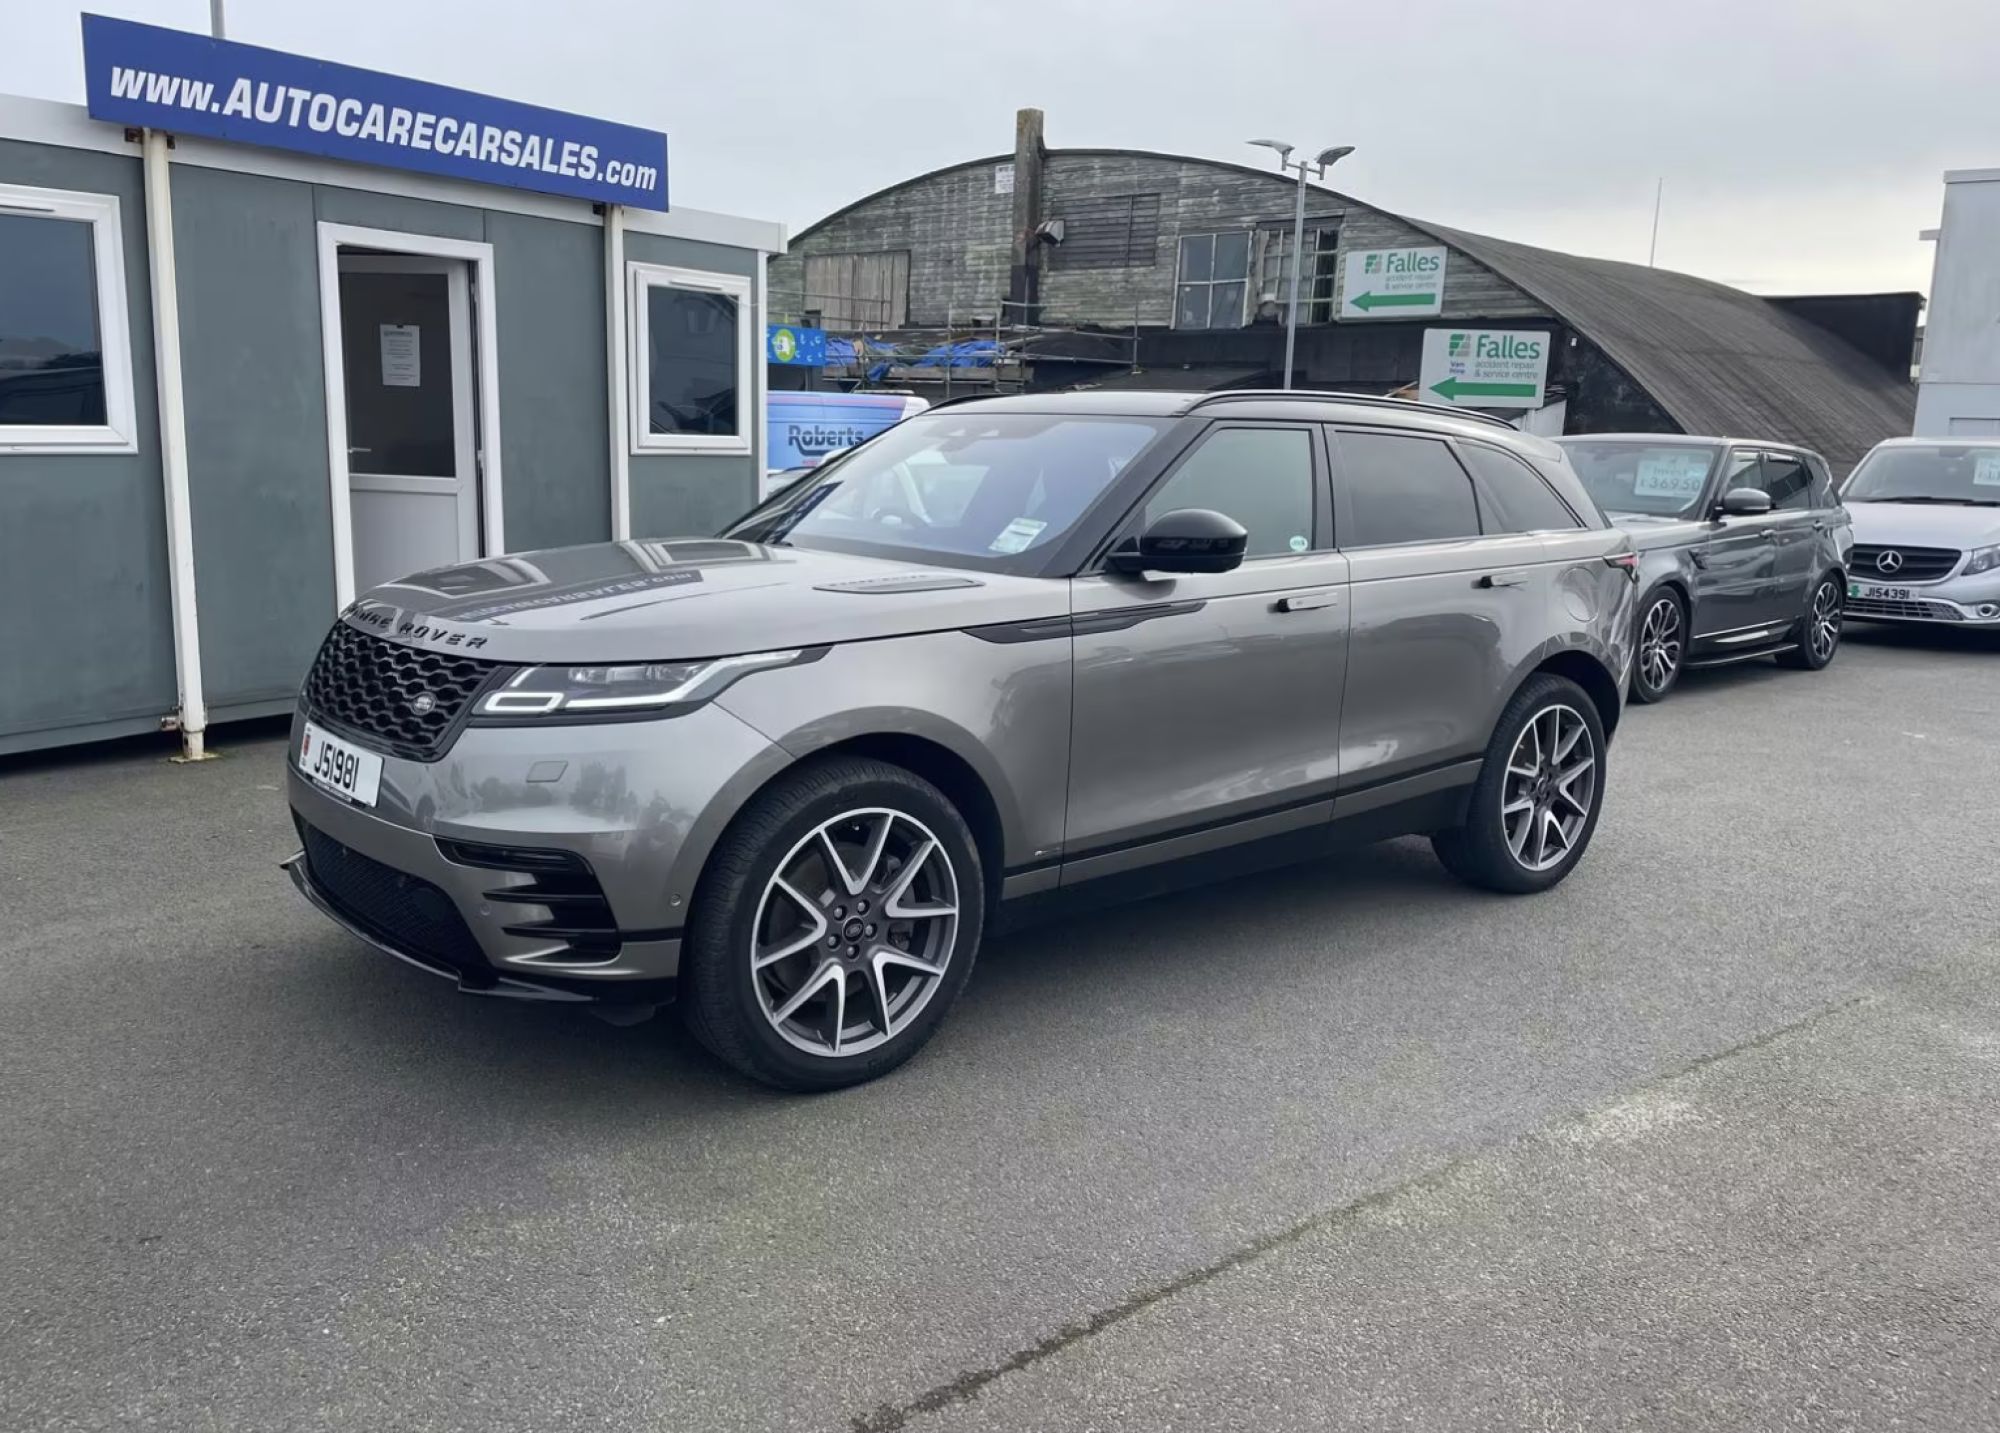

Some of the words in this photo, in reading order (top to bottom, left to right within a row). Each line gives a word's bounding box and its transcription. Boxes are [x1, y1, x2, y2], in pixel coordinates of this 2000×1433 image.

[110, 65, 657, 192] www.AUTOCARECARSALES.com
[1386, 251, 1440, 273] Falles
[1476, 334, 1541, 359] Falles
[1475, 360, 1509, 369] accident
[1511, 361, 1535, 370] repair
[1482, 370, 1510, 378] service
[1511, 371, 1538, 379] centre
[788, 424, 864, 449] Roberts
[398, 621, 489, 649] ROVER
[313, 739, 360, 793] J51981
